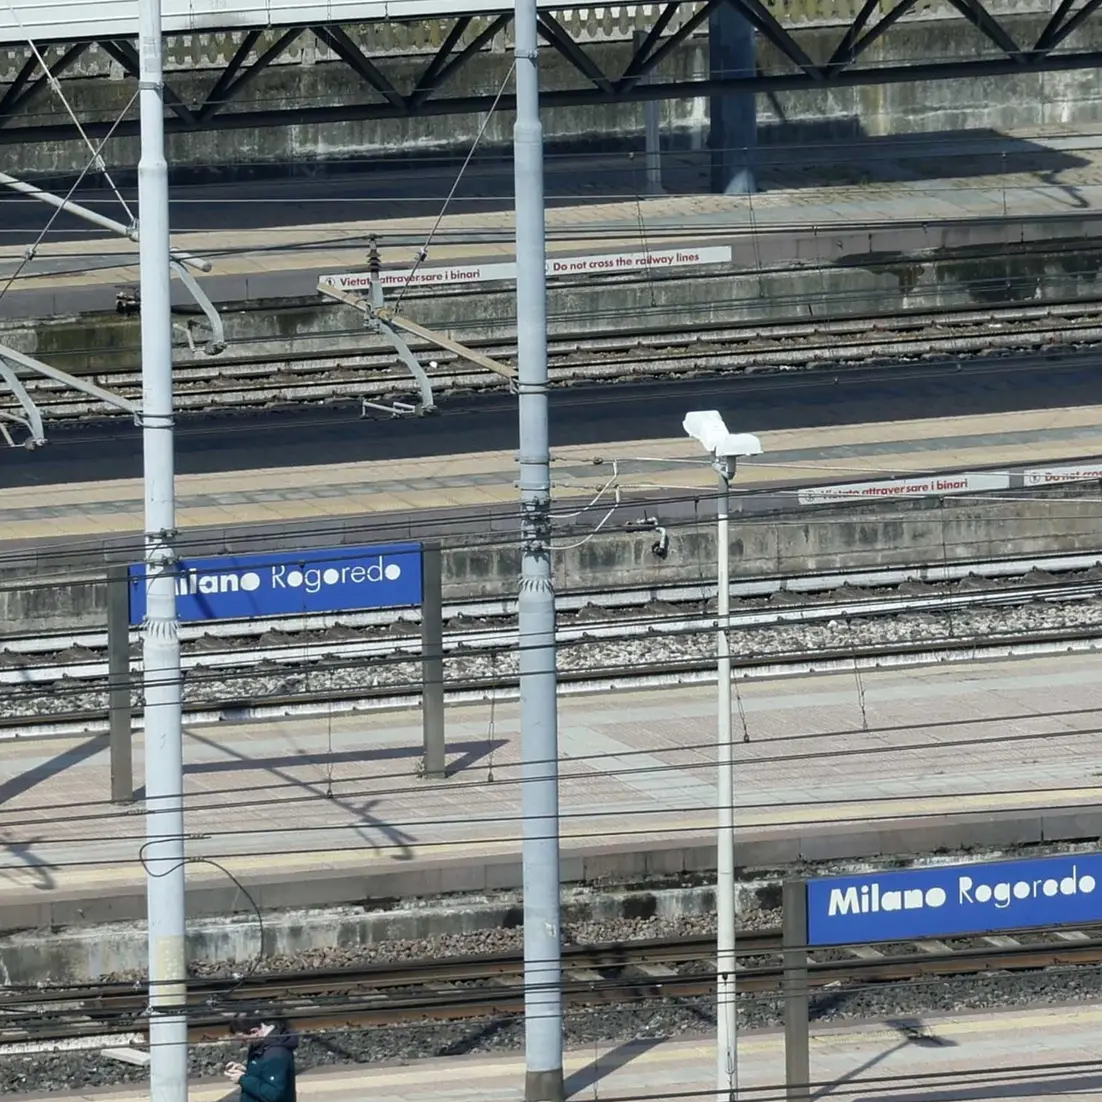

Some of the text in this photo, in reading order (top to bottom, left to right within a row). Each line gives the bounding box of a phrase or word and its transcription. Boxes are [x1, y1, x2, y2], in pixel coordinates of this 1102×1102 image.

[553, 252, 700, 271] Do not cross the railway lines
[339, 277, 371, 287] Vietat
[450, 269, 480, 279] binari
[862, 484, 929, 495] attraversare
[936, 479, 968, 490] binari
[175, 555, 401, 596] ilano Rogoredo
[828, 864, 1096, 916] Milano Rogoredo
